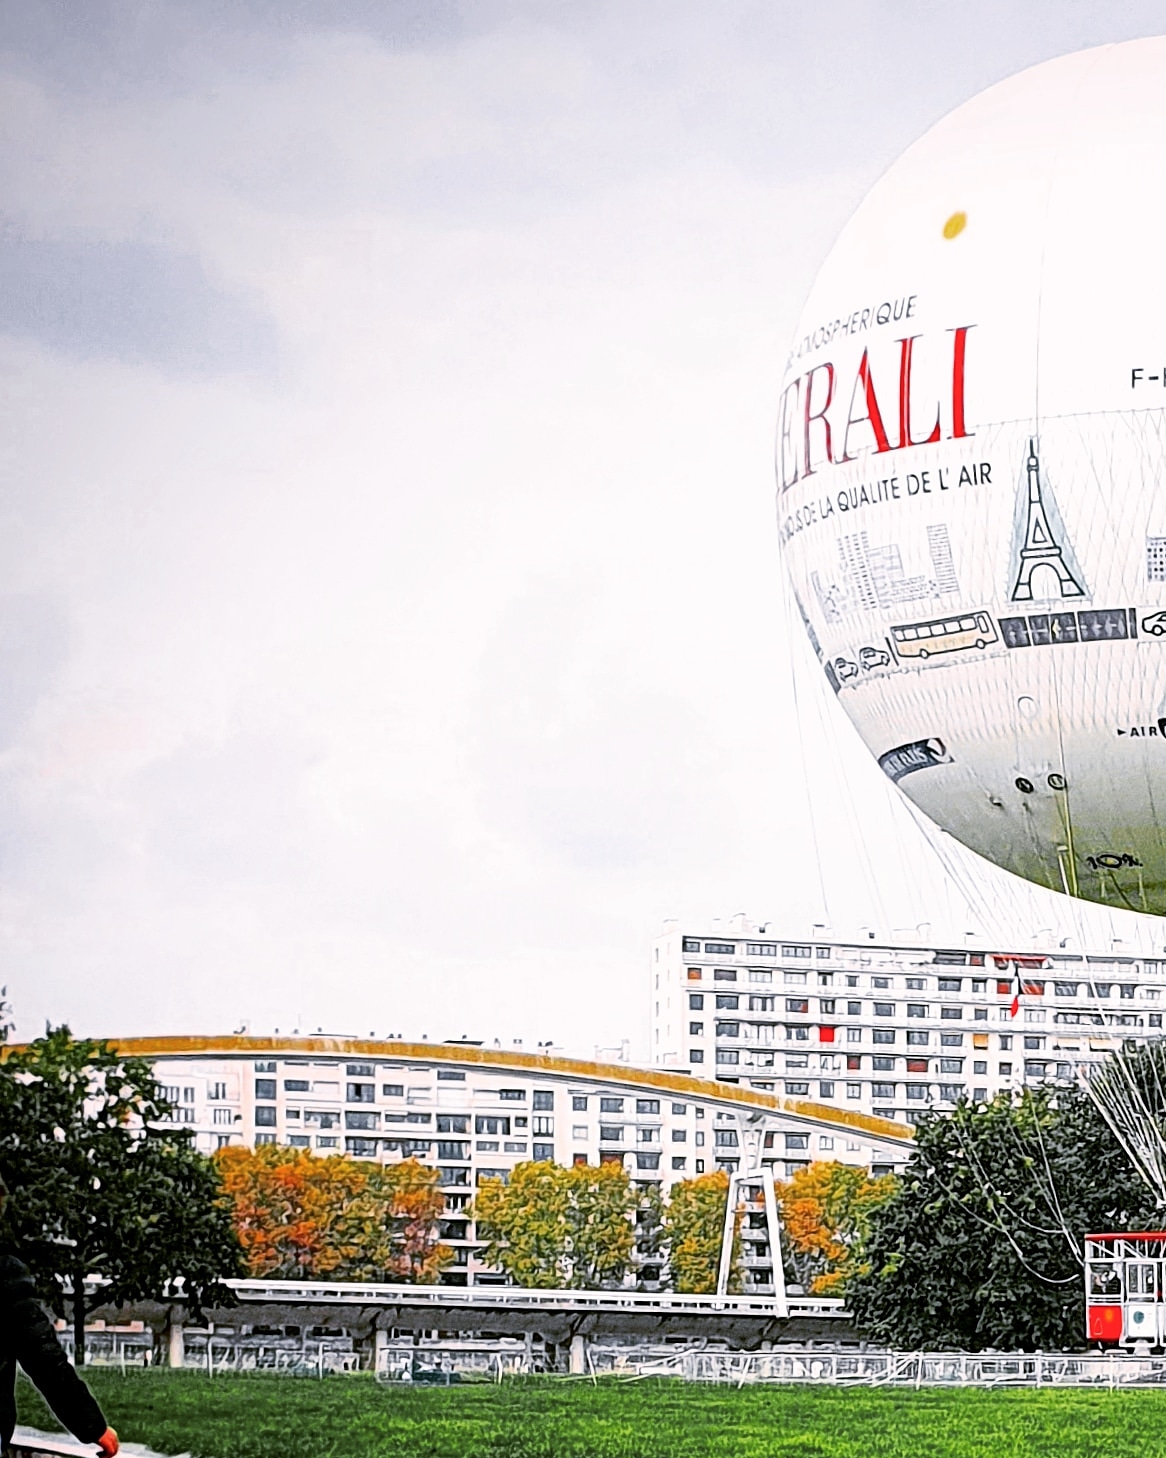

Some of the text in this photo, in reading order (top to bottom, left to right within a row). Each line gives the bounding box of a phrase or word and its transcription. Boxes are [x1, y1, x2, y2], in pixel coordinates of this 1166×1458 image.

[819, 495, 836, 519] LA
[906, 471, 932, 496] DE
[958, 462, 993, 488] AIR
[1129, 726, 1158, 737] AIR
